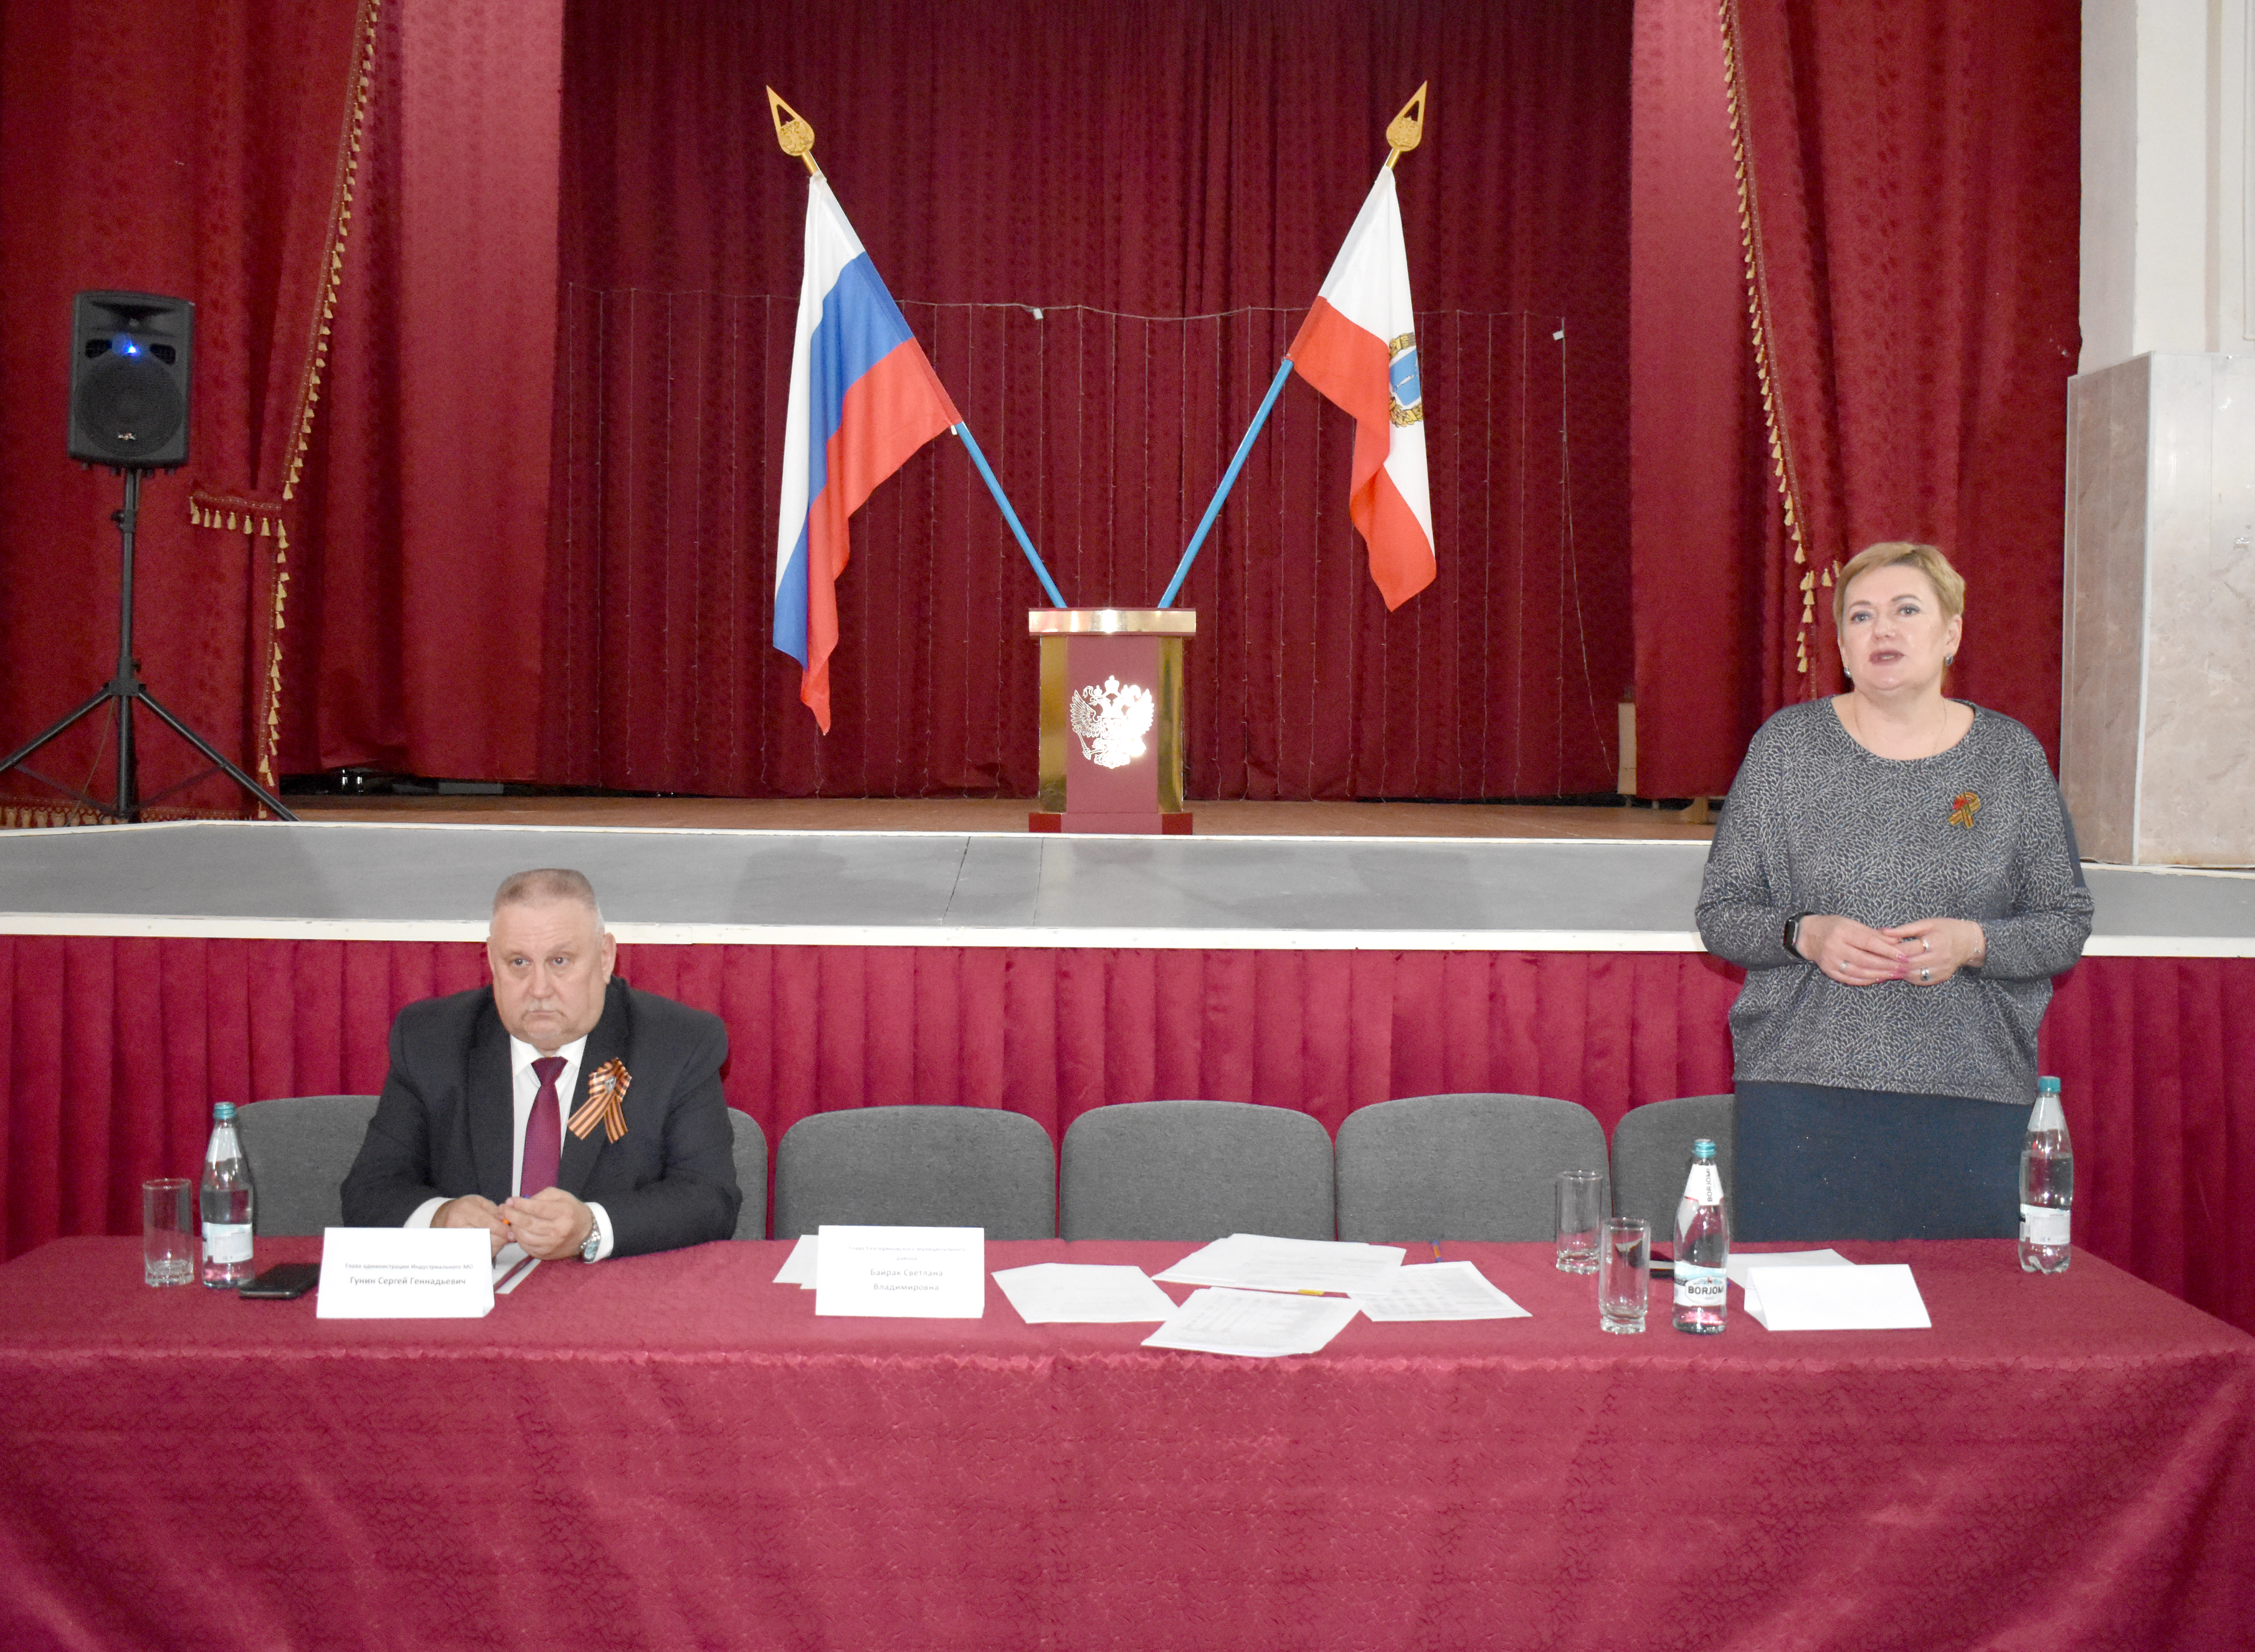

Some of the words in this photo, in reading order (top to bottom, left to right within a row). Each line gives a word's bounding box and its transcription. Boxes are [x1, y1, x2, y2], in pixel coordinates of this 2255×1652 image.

[870, 1268, 901, 1277] Байрак
[350, 1276, 375, 1285] Гунин
[378, 1277, 408, 1286] Сергей
[410, 1277, 466, 1286] Геннадьевич
[874, 1283, 939, 1291] Владимировна
[1688, 1286, 1723, 1295] BORJOM
